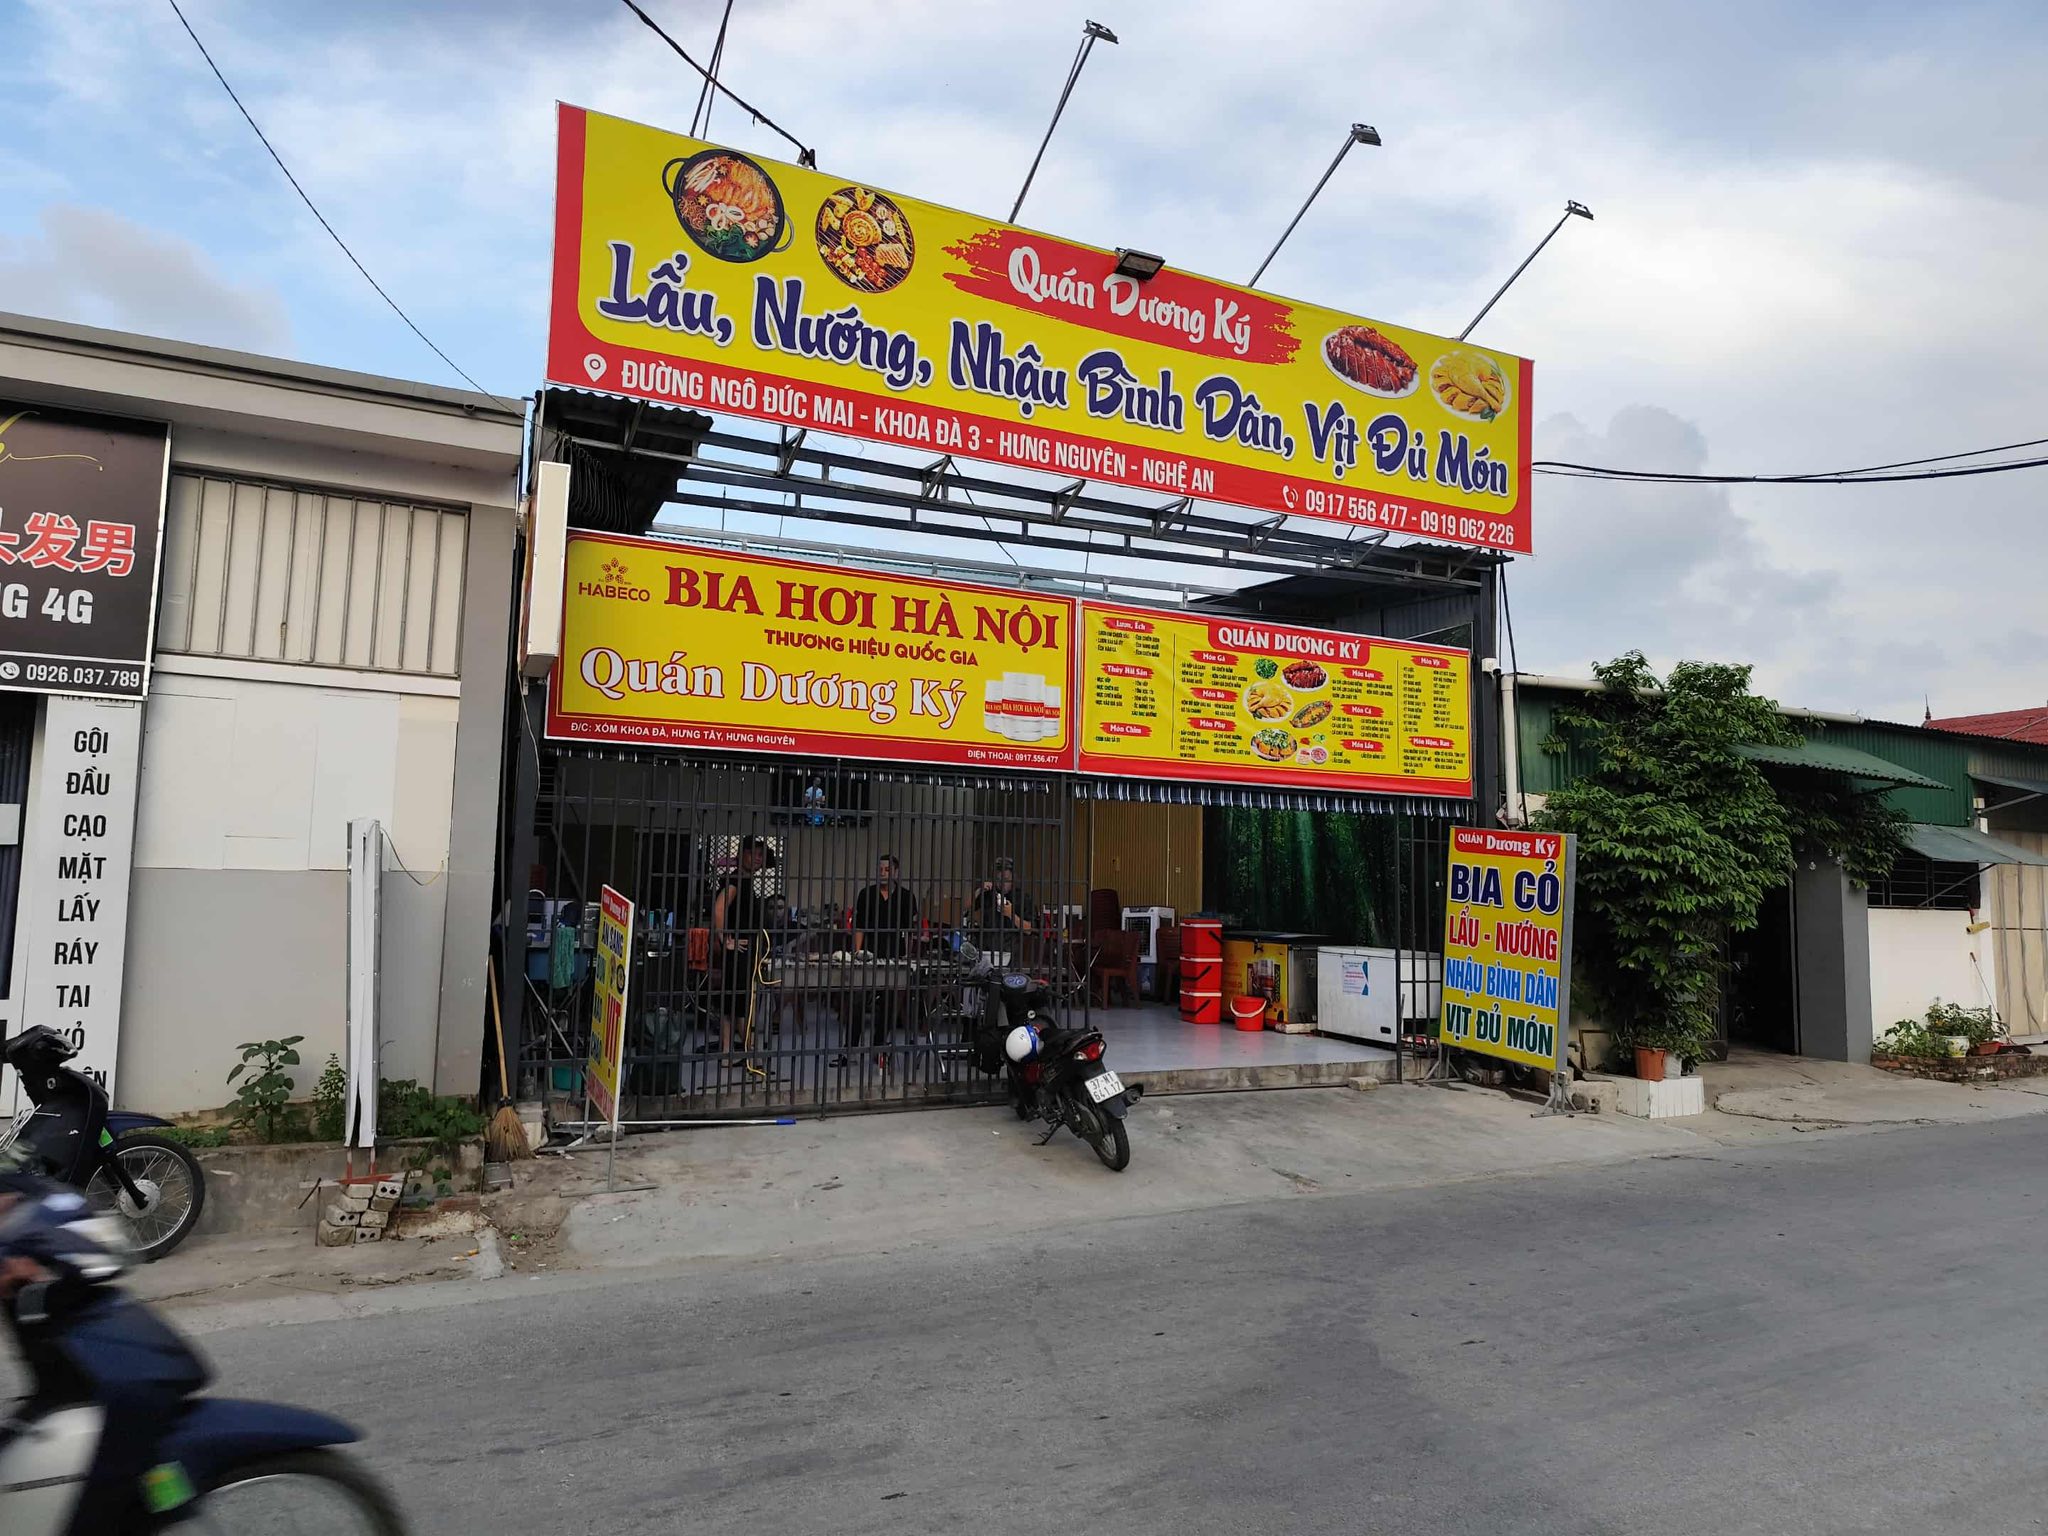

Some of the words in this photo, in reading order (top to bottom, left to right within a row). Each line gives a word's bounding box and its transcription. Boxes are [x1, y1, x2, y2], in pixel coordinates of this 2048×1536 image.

[1007, 246, 1095, 309] Quán
[1103, 273, 1205, 344] Dương
[1213, 298, 1252, 355] Ký
[596, 240, 734, 347] Lẩu,
[751, 273, 934, 391] Nướng,
[948, 317, 1069, 419] Nhậu
[1075, 348, 1184, 432] Bình
[1195, 373, 1297, 461] Dân,
[1302, 398, 1360, 480] Vịt
[1366, 413, 1429, 482] Đủ
[1434, 429, 1510, 498] Món
[621, 359, 703, 400] ĐƯỜNG
[711, 376, 756, 410] NGÔ
[762, 383, 807, 419] ĐỨC
[813, 397, 853, 428] MAI
[874, 408, 930, 442] KHOA
[935, 417, 962, 449] ĐÀ
[968, 425, 980, 451] 3
[999, 430, 1050, 464] HƯNG
[1055, 440, 1126, 478] NGUYÊN
[1142, 460, 1187, 492] NGHỆ
[1191, 467, 1215, 494] AN
[1305, 488, 1345, 517] 0917
[1348, 495, 1377, 522] 556
[1379, 501, 1408, 527] 477
[1420, 509, 1456, 536] 0919
[1459, 519, 1485, 542] 062
[1489, 523, 1514, 545] 226
[0, 583, 29, 619] G
[41, 587, 94, 624] 4G
[578, 582, 650, 602] HABECO
[664, 566, 764, 616] BIA
[776, 580, 878, 629] HƠI
[890, 593, 963, 639] HÀ
[973, 604, 1059, 654] NỘI
[764, 629, 845, 652] THƯƠNG
[849, 637, 890, 659] HIỆU
[894, 641, 946, 663] QUỐC
[950, 650, 979, 666] GIA
[1218, 627, 1269, 649] QUÁN
[1275, 633, 1335, 657] DƯƠNG
[1339, 640, 1361, 660] KÝ
[26, 664, 140, 688] 0926.037.789
[580, 647, 724, 700] Quán
[741, 661, 898, 724] Dương
[910, 678, 967, 729] Ký
[74, 727, 109, 758] GỘI
[570, 722, 592, 733] Đ/C:
[594, 723, 618, 734] XÓM
[621, 726, 649, 737] KHOA
[652, 725, 669, 738] ĐÀ,
[671, 729, 701, 739] HƯNG
[703, 729, 724, 742] TÂY,
[726, 733, 754, 742] HƯNG
[756, 734, 796, 746] NGUYÊN
[967, 750, 987, 760] ĐIỆN
[988, 751, 1014, 763] THOẠI:
[1015, 753, 1059, 763] 0917.556.477
[66, 765, 110, 795] ĐẦU
[63, 814, 107, 842] CẠO
[1458, 832, 1483, 845] QUÁN
[1486, 834, 1531, 857] Dương
[1535, 838, 1556, 858] Ký
[58, 851, 107, 885] MẶT
[1450, 863, 1504, 908] BIA
[1514, 859, 1560, 915] CỎ
[58, 893, 100, 922] LẤY
[54, 936, 99, 965] RÁY
[1449, 906, 1479, 949] LẨU
[1495, 919, 1558, 962] NƯỚNG
[56, 984, 90, 1008] TAI
[1445, 955, 1483, 998] NHẬU
[1486, 961, 1521, 1002] BÌNH
[1525, 969, 1557, 1010] DÂN
[1445, 1001, 1472, 1041] VỊT
[1476, 1002, 1501, 1044] ĐỦ
[1506, 1013, 1554, 1058] MÓN
